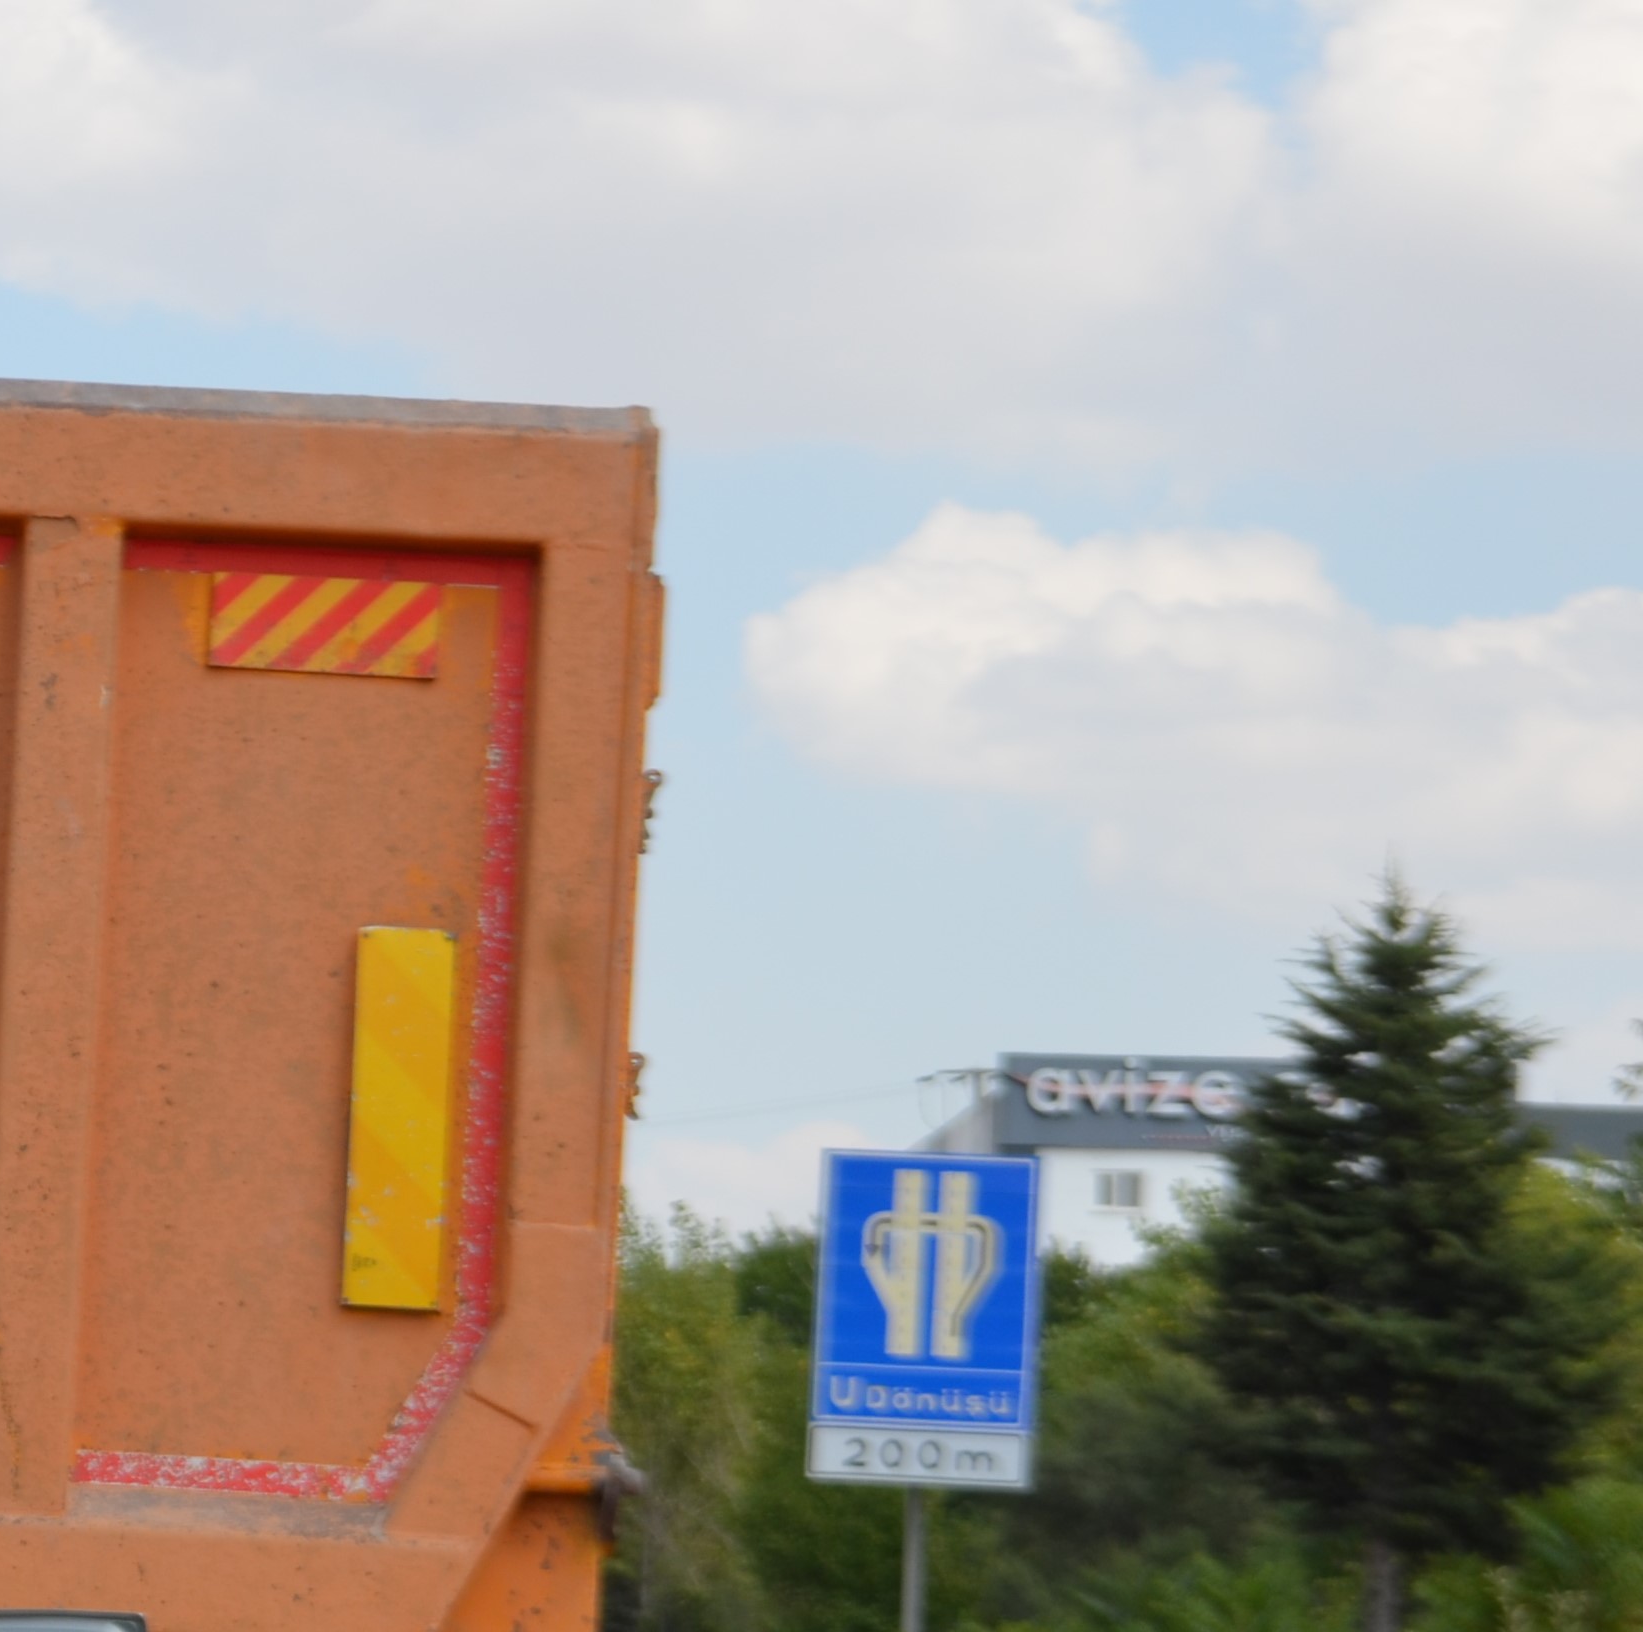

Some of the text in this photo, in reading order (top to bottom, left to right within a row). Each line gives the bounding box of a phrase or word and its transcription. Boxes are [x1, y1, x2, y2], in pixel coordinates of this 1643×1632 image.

[829, 1375, 862, 1408] U
[842, 1437, 994, 1471] 200 m
